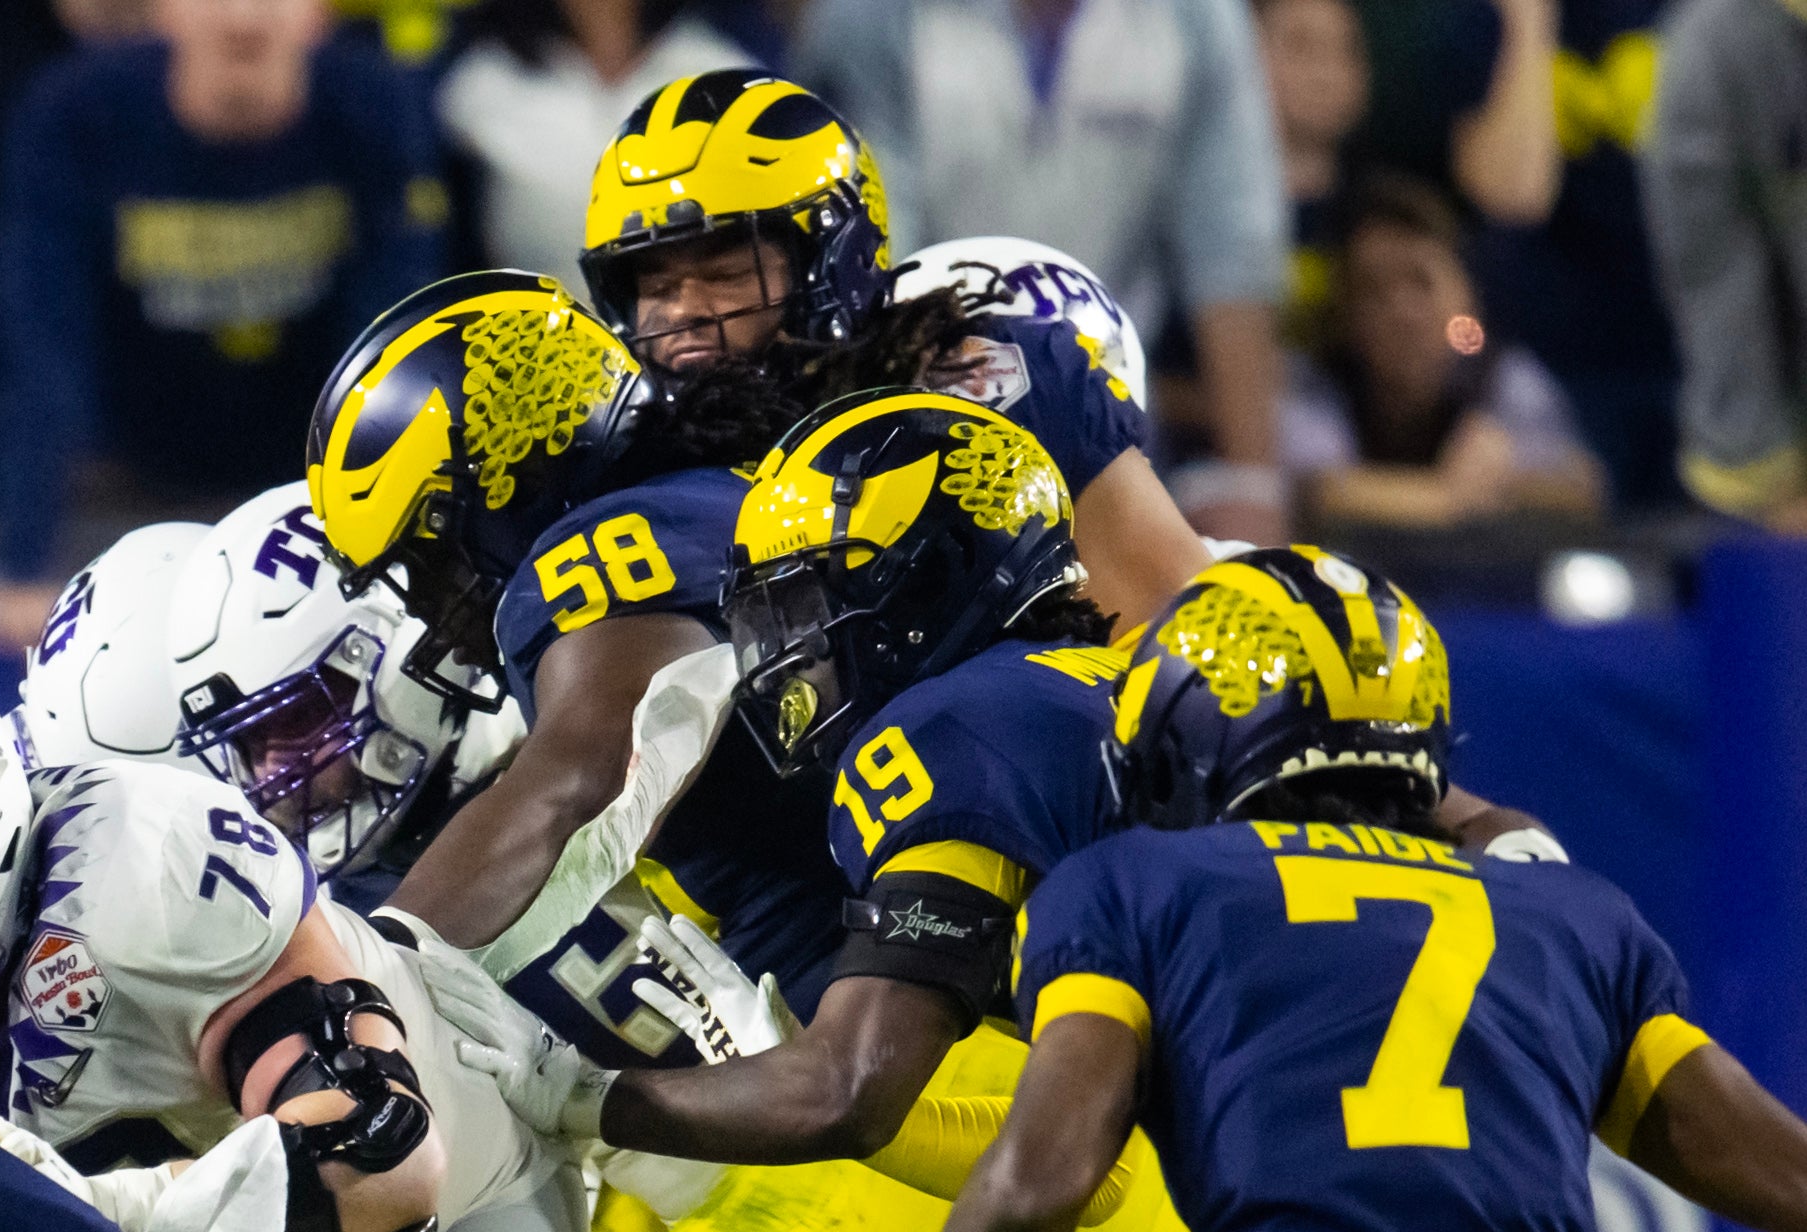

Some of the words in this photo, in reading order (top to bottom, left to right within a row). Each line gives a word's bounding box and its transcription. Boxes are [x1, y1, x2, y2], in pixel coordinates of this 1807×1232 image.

[1004, 262, 1122, 320] TCU
[253, 504, 329, 590] TC
[533, 512, 678, 633] 58
[833, 726, 935, 858] 19
[198, 806, 279, 920] 78
[904, 914, 966, 939] Douglas
[1273, 854, 1497, 1151] 7
